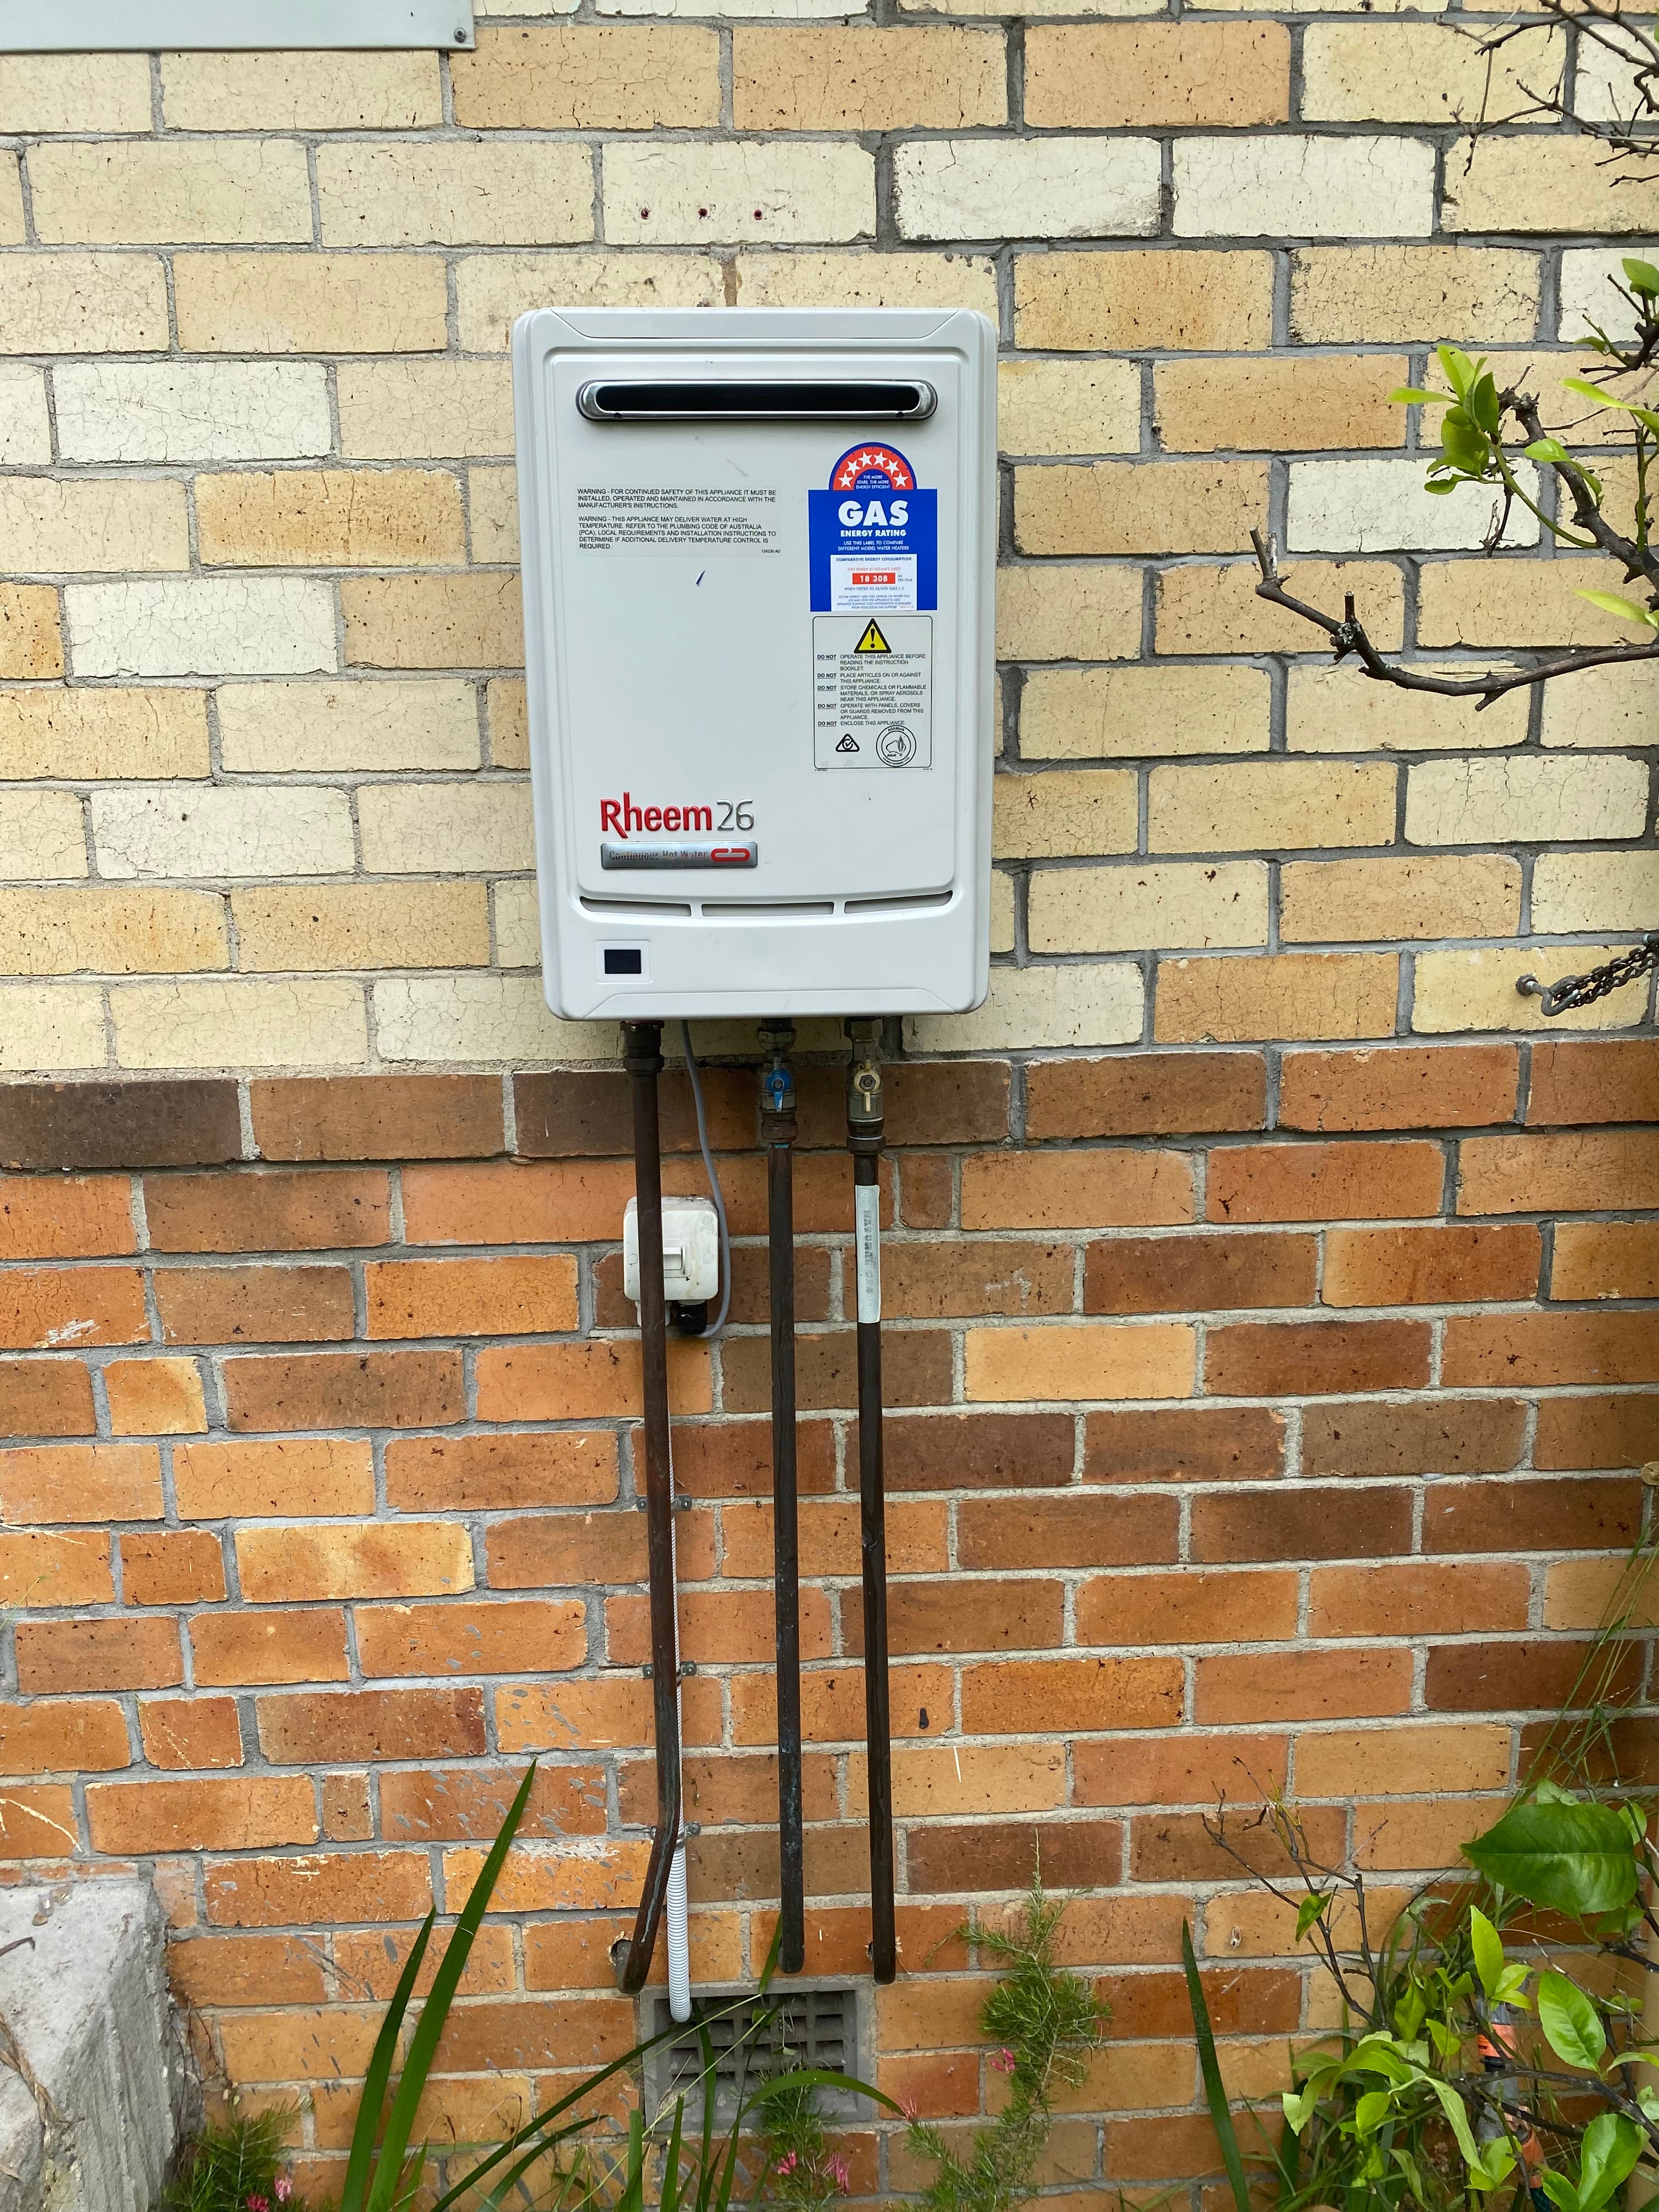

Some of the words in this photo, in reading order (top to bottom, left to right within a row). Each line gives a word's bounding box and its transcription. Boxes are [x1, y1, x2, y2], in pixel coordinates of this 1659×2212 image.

[838, 500, 909, 527] GAS
[600, 791, 712, 838] Rheem
[716, 799, 754, 831] 26
[609, 850, 659, 861] Continuous
[662, 850, 679, 860] Hot
[680, 850, 707, 860] Water
